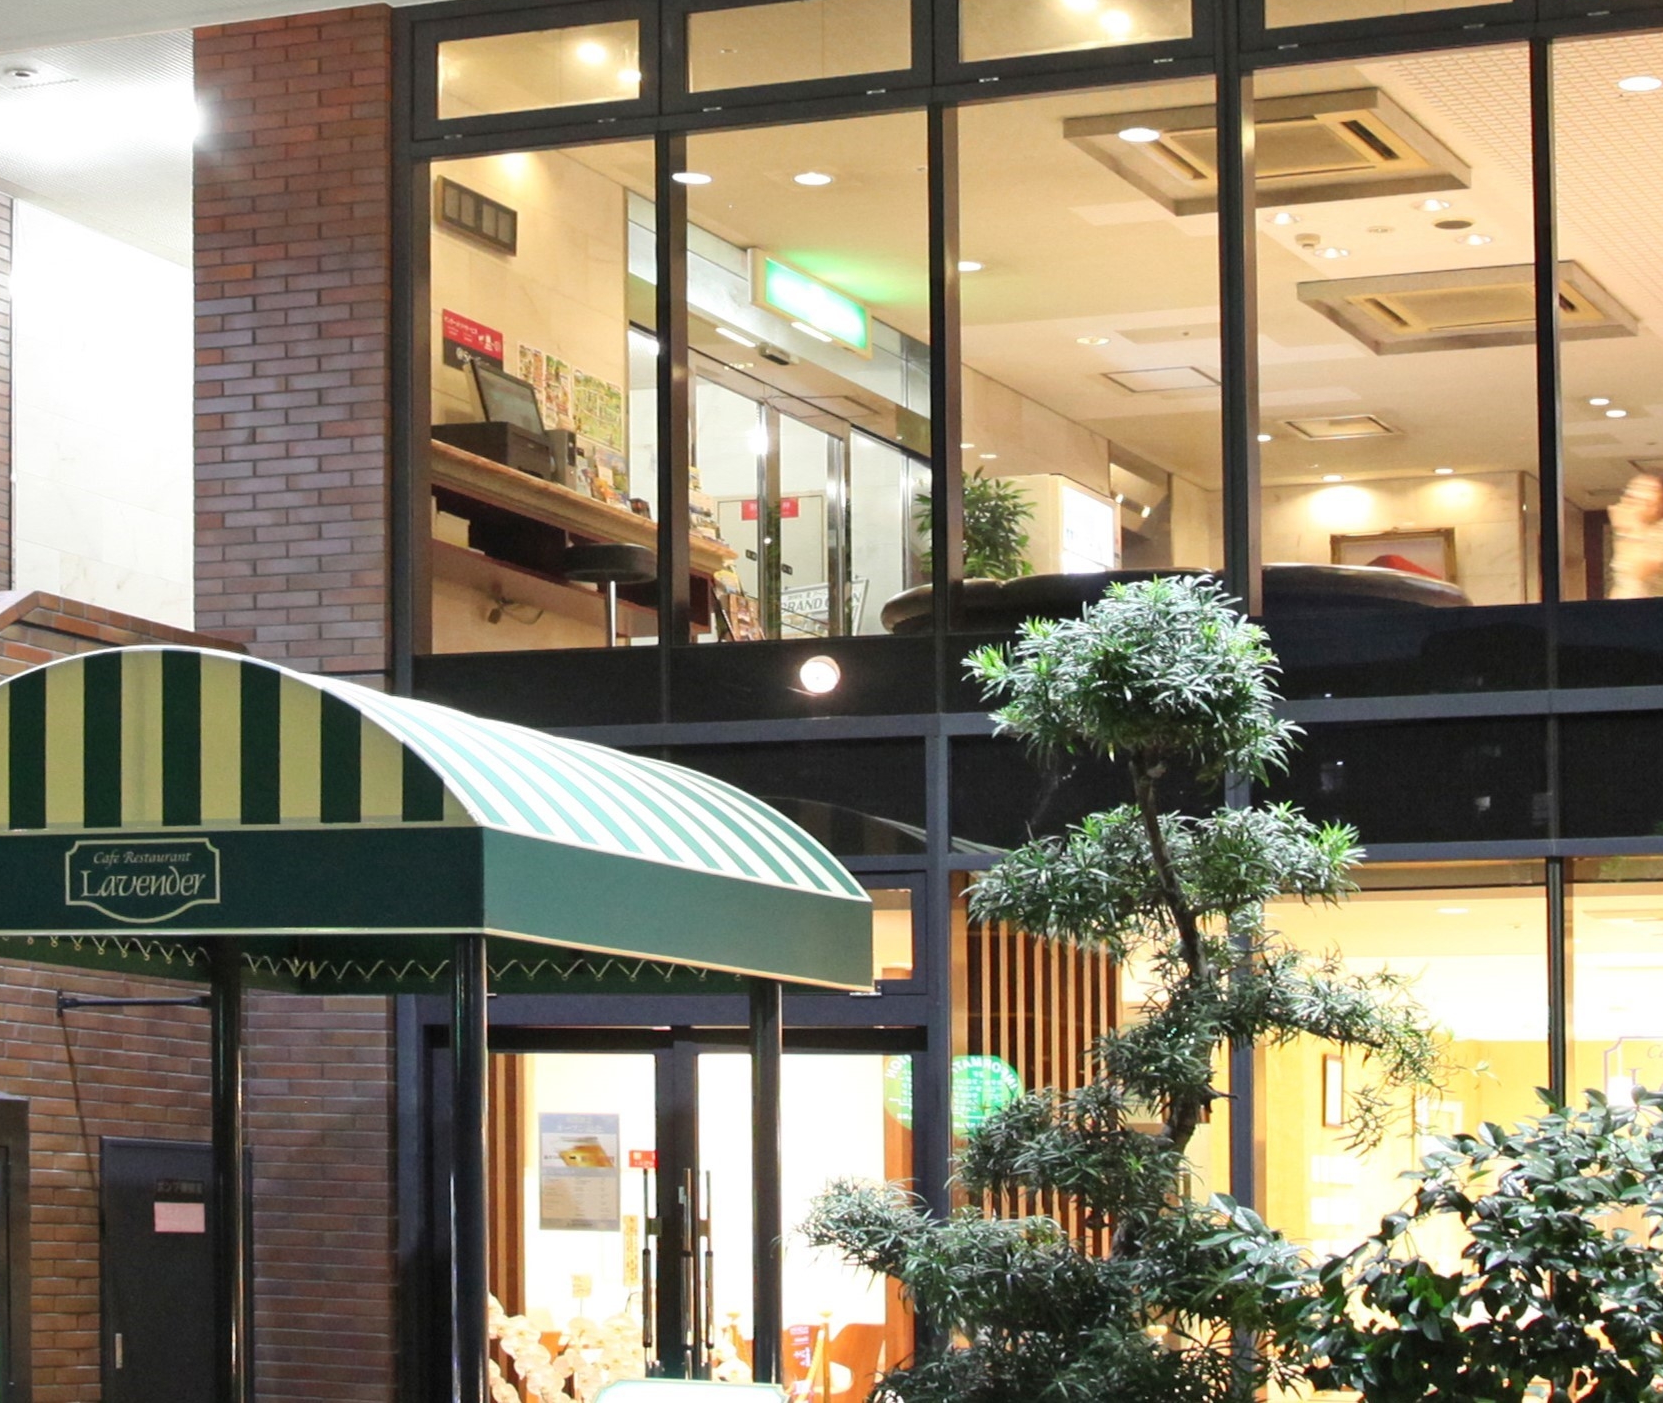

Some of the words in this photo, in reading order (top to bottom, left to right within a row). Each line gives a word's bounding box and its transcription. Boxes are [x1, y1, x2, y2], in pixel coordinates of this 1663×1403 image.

[93, 848, 120, 870] Cafe
[123, 850, 192, 864] Restaurant
[80, 865, 206, 897] Lavender
